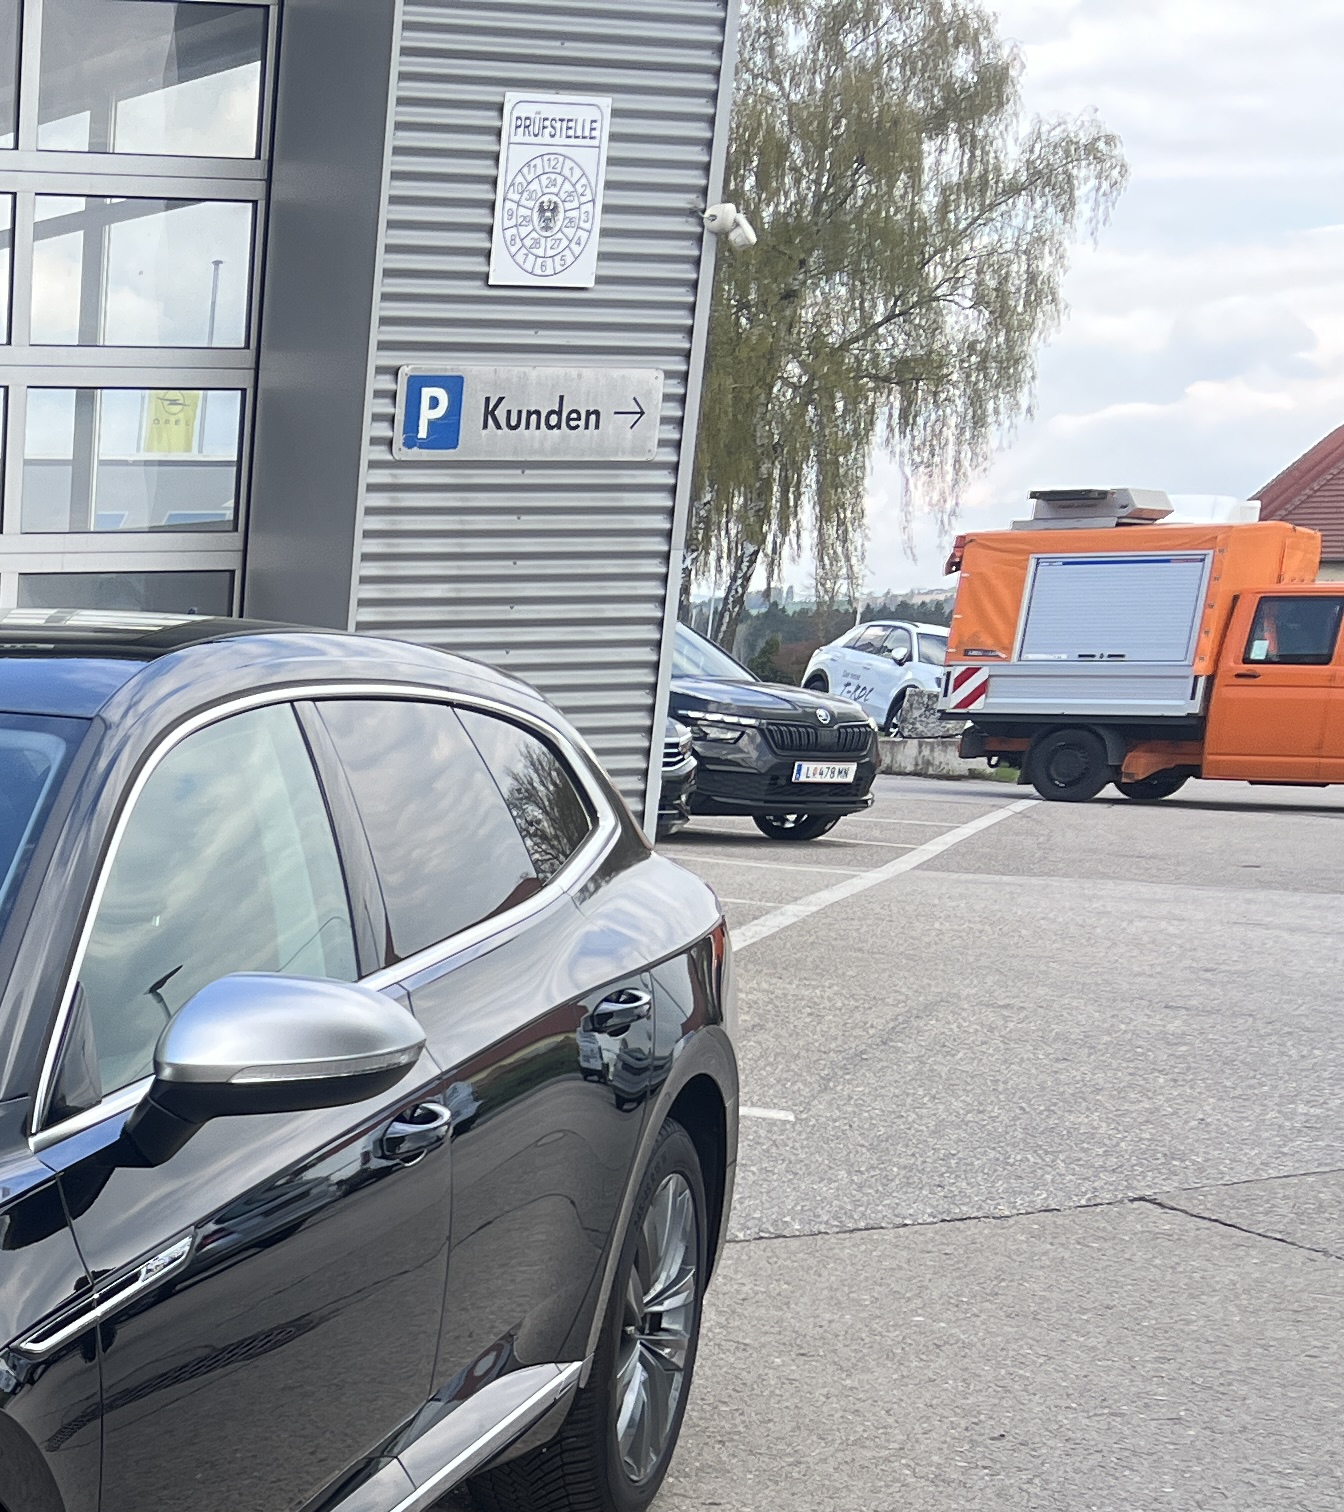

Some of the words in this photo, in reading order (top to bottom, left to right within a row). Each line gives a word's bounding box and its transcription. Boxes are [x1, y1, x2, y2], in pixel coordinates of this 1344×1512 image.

[514, 111, 599, 140] PRÜFSTELLE
[526, 163, 538, 175] 11
[546, 157, 560, 170] 12
[568, 166, 575, 178] 1
[511, 181, 524, 195] 10
[544, 176, 558, 189] 24
[563, 190, 576, 203] 25
[579, 183, 588, 197] 2
[506, 208, 515, 221] 9
[582, 210, 590, 223] 3
[563, 216, 577, 229] 26
[509, 234, 517, 247] 8
[549, 237, 563, 250] 27
[574, 234, 582, 248] 4
[540, 259, 547, 273] 6
[559, 254, 567, 267] 5
[416, 386, 449, 440] P
[482, 395, 601, 431] Kunden
